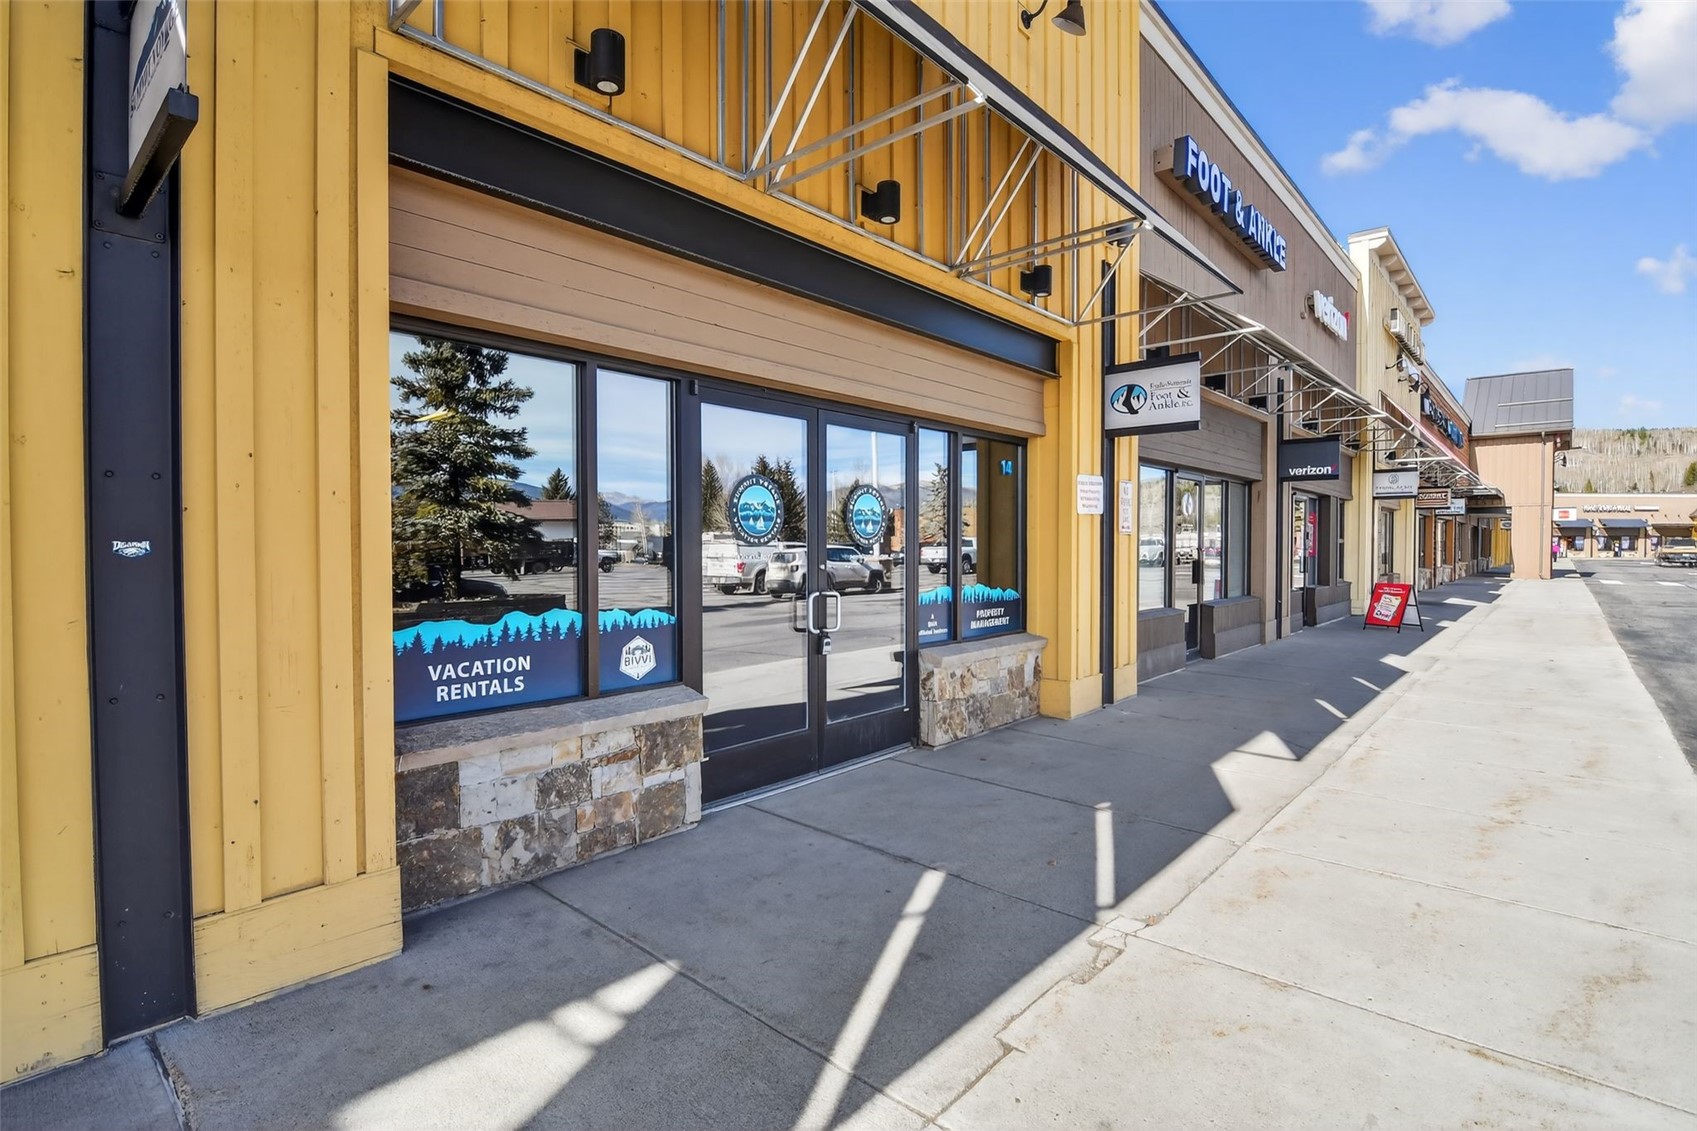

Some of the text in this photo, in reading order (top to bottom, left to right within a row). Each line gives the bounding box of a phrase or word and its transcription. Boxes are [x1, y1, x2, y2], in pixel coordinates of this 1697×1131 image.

[1186, 136, 1286, 271] FOOT & ANKLE
[1150, 386, 1191, 401] Foot &
[1289, 465, 1331, 476] verizon
[976, 607, 1005, 619] PROPERTY
[970, 616, 1010, 630] MANAGEMENT
[624, 654, 652, 667] BIVVI
[427, 655, 531, 682] VACATION
[436, 675, 525, 702] RENTALS
